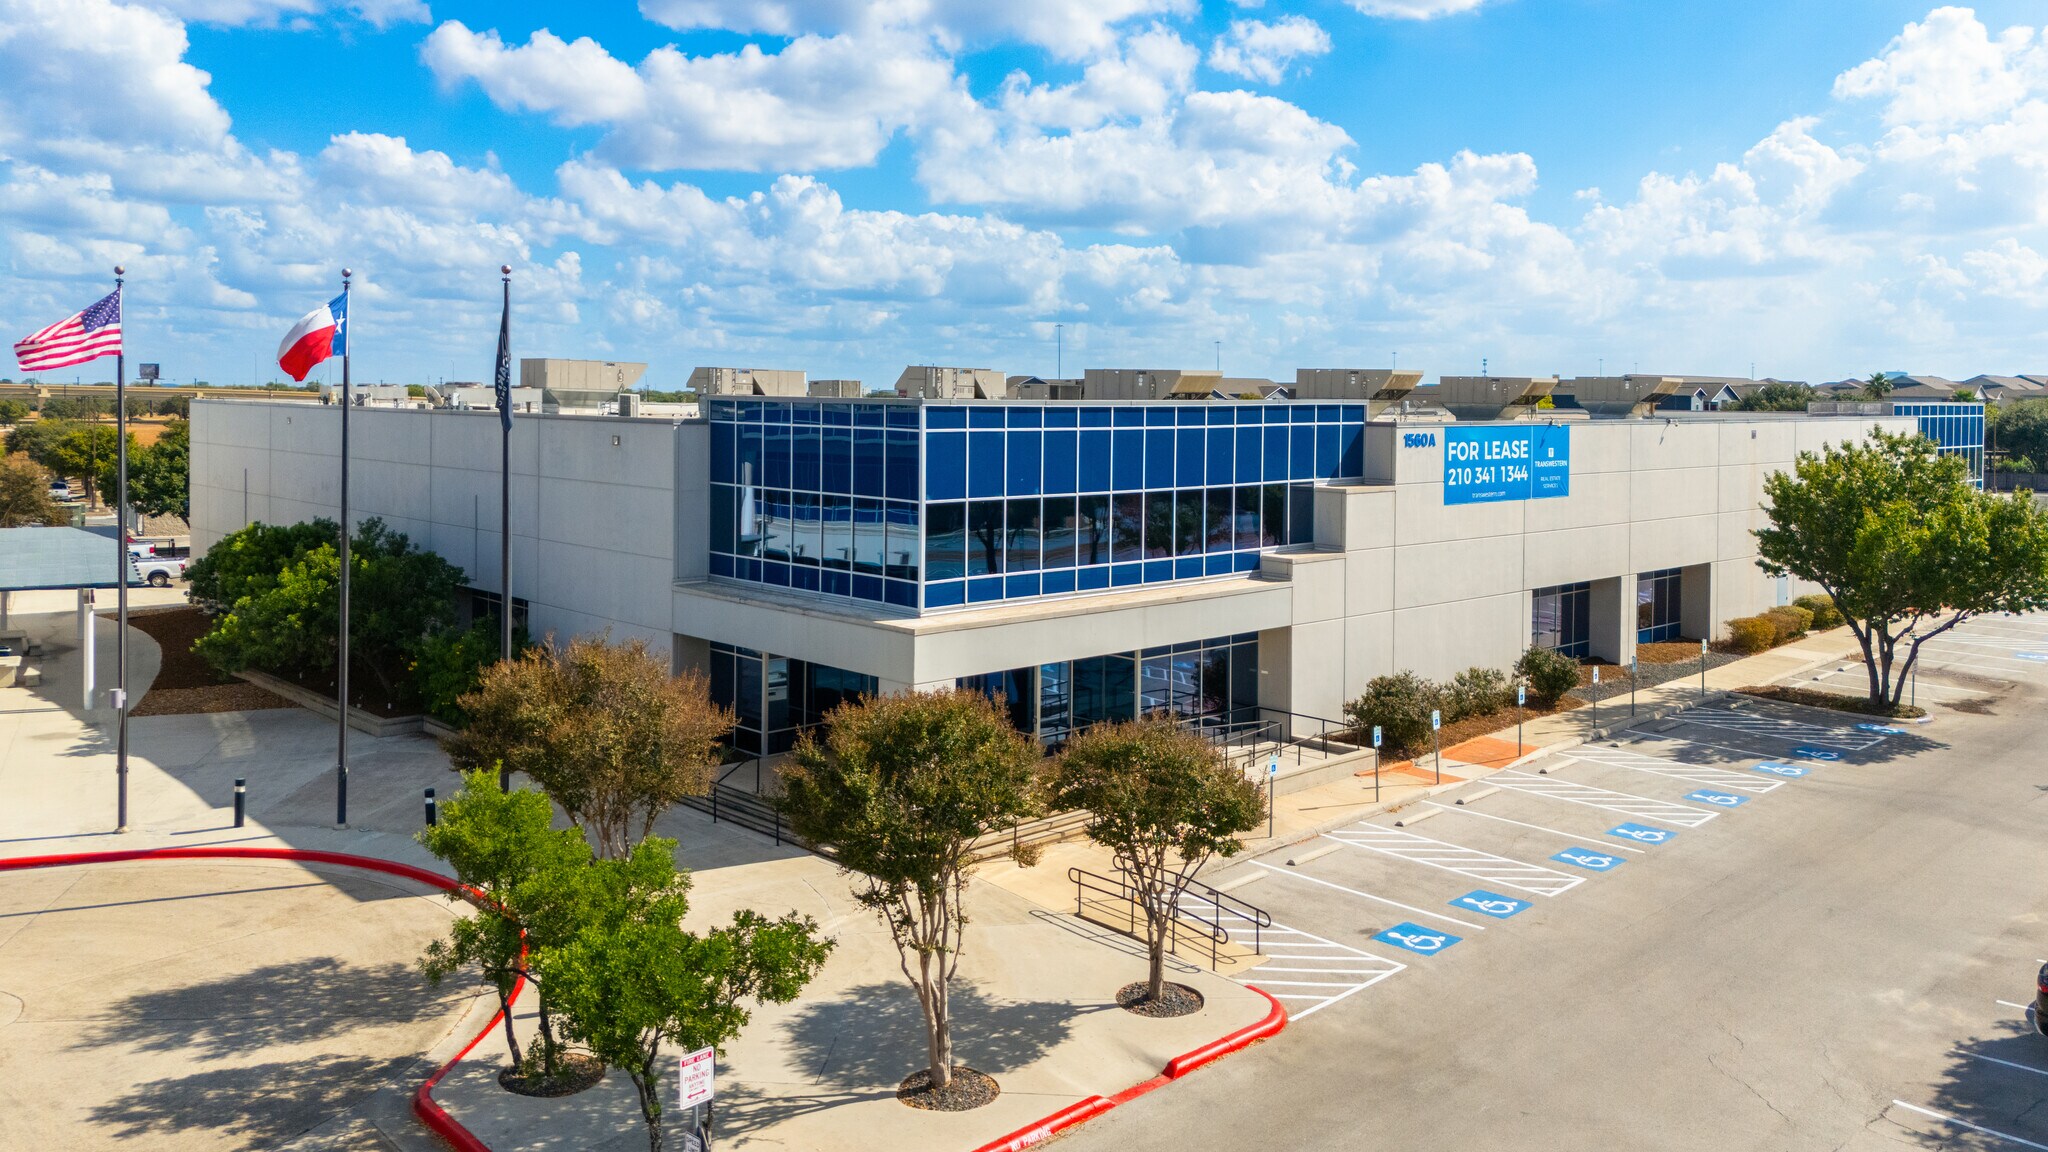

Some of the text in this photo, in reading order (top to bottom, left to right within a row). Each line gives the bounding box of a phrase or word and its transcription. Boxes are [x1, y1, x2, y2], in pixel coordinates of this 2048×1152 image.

[1448, 440, 1529, 461] FOR LEASE
[1535, 460, 1568, 468] TRANSWESTERN
[1448, 465, 1529, 486] 210 341 1344
[684, 1052, 709, 1067] FIRE LANE
[692, 1064, 701, 1072] NO
[684, 1069, 710, 1084] PARKING
[1010, 1126, 1052, 1152] NO PARKING
